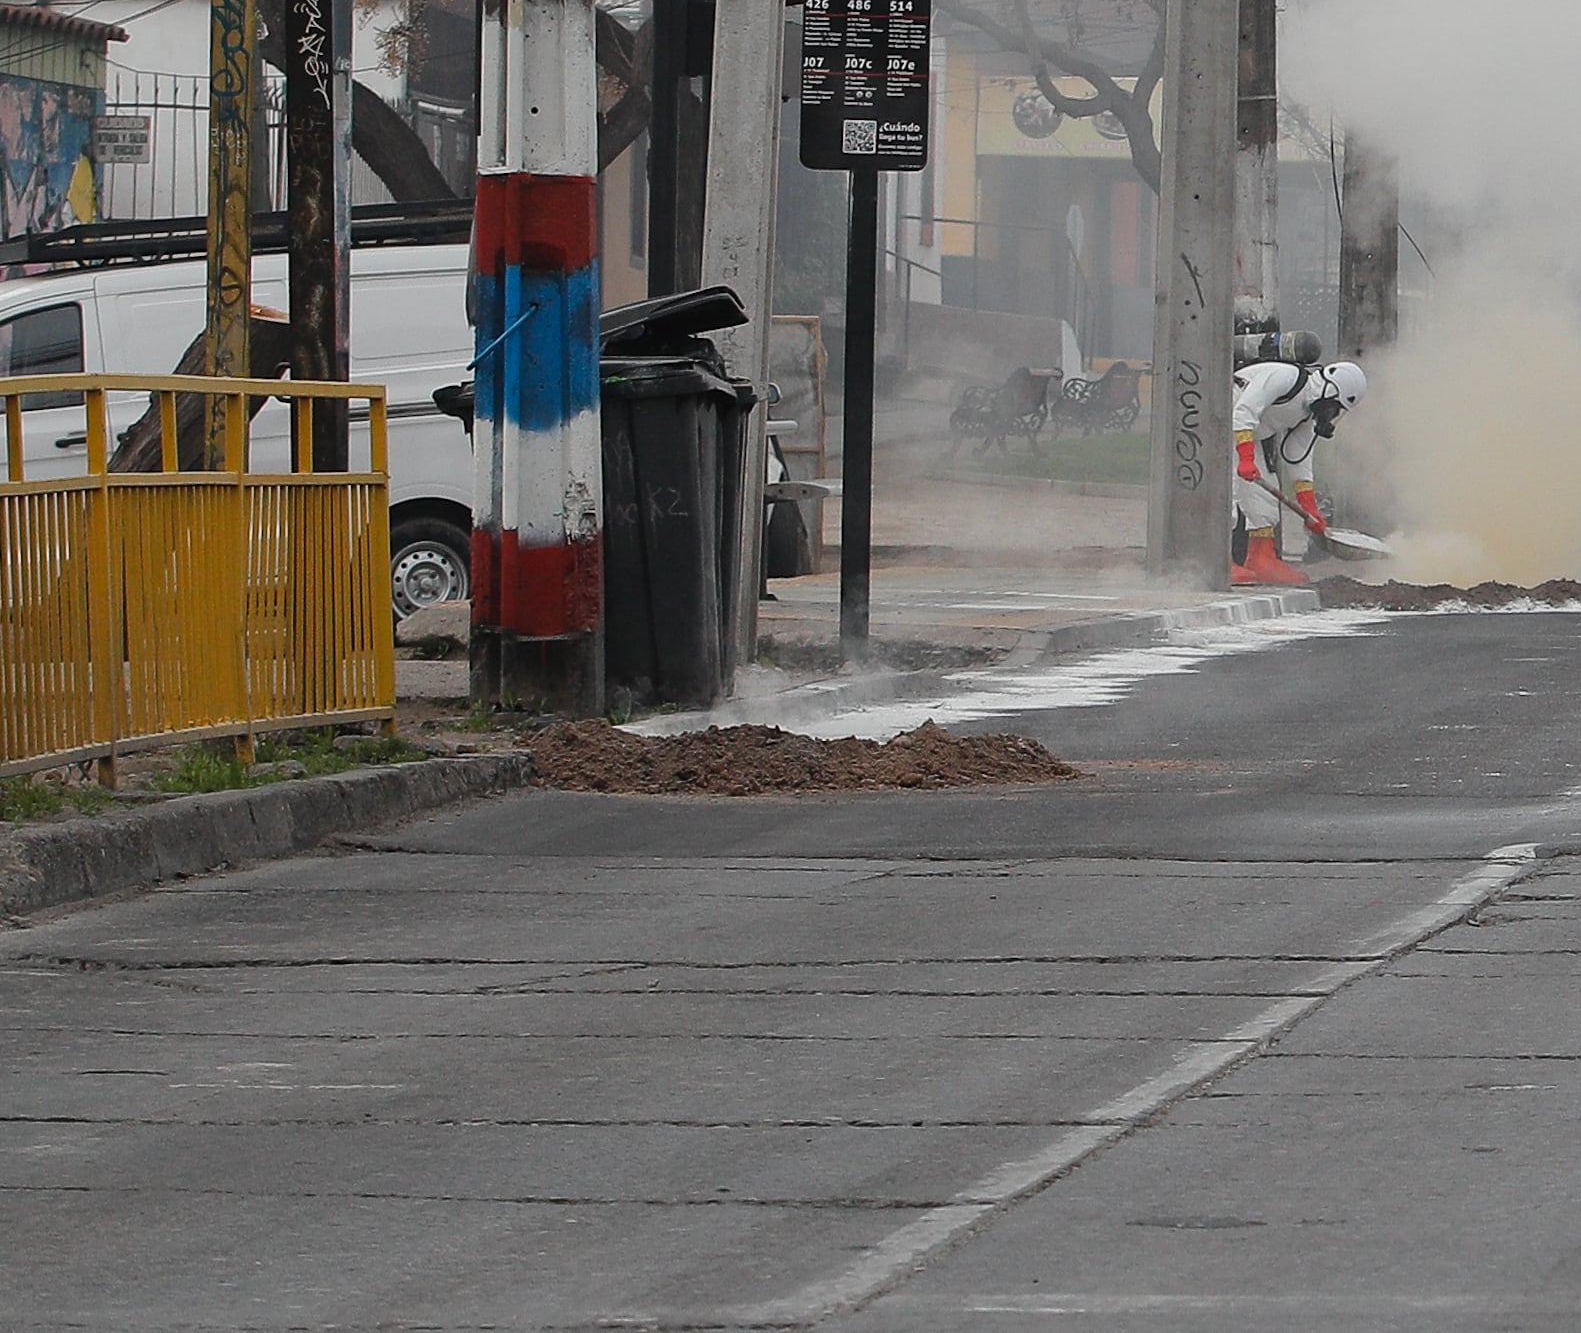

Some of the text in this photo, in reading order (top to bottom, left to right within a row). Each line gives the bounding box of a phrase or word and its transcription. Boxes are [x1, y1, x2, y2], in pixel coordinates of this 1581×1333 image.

[847, 0, 872, 11] 486
[889, 0, 913, 12] 514
[803, 56, 825, 68] J07
[844, 57, 873, 69] J07c
[886, 59, 916, 71] J07e
[878, 121, 921, 132] ¿Cuándo
